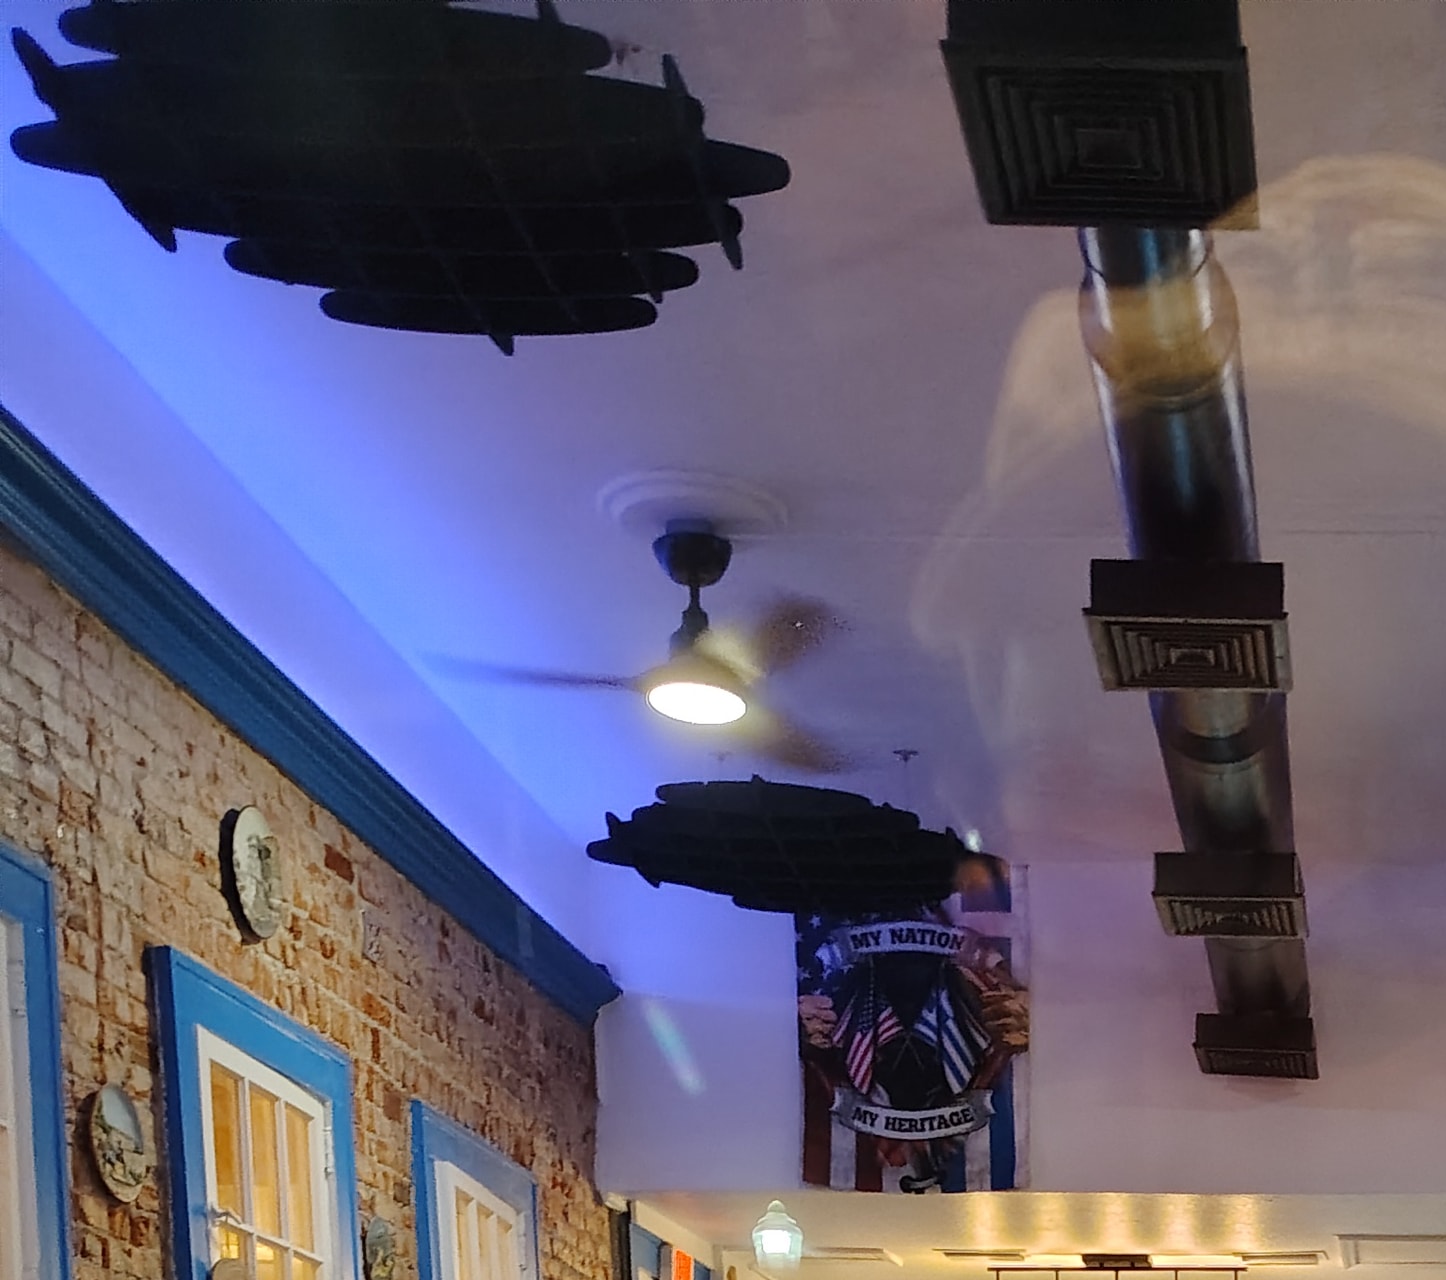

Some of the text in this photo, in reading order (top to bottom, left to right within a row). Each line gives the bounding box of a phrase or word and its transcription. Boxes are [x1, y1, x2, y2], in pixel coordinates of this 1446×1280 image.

[850, 927, 965, 950] MY NATION
[852, 1106, 974, 1133] MY HERITAGE
